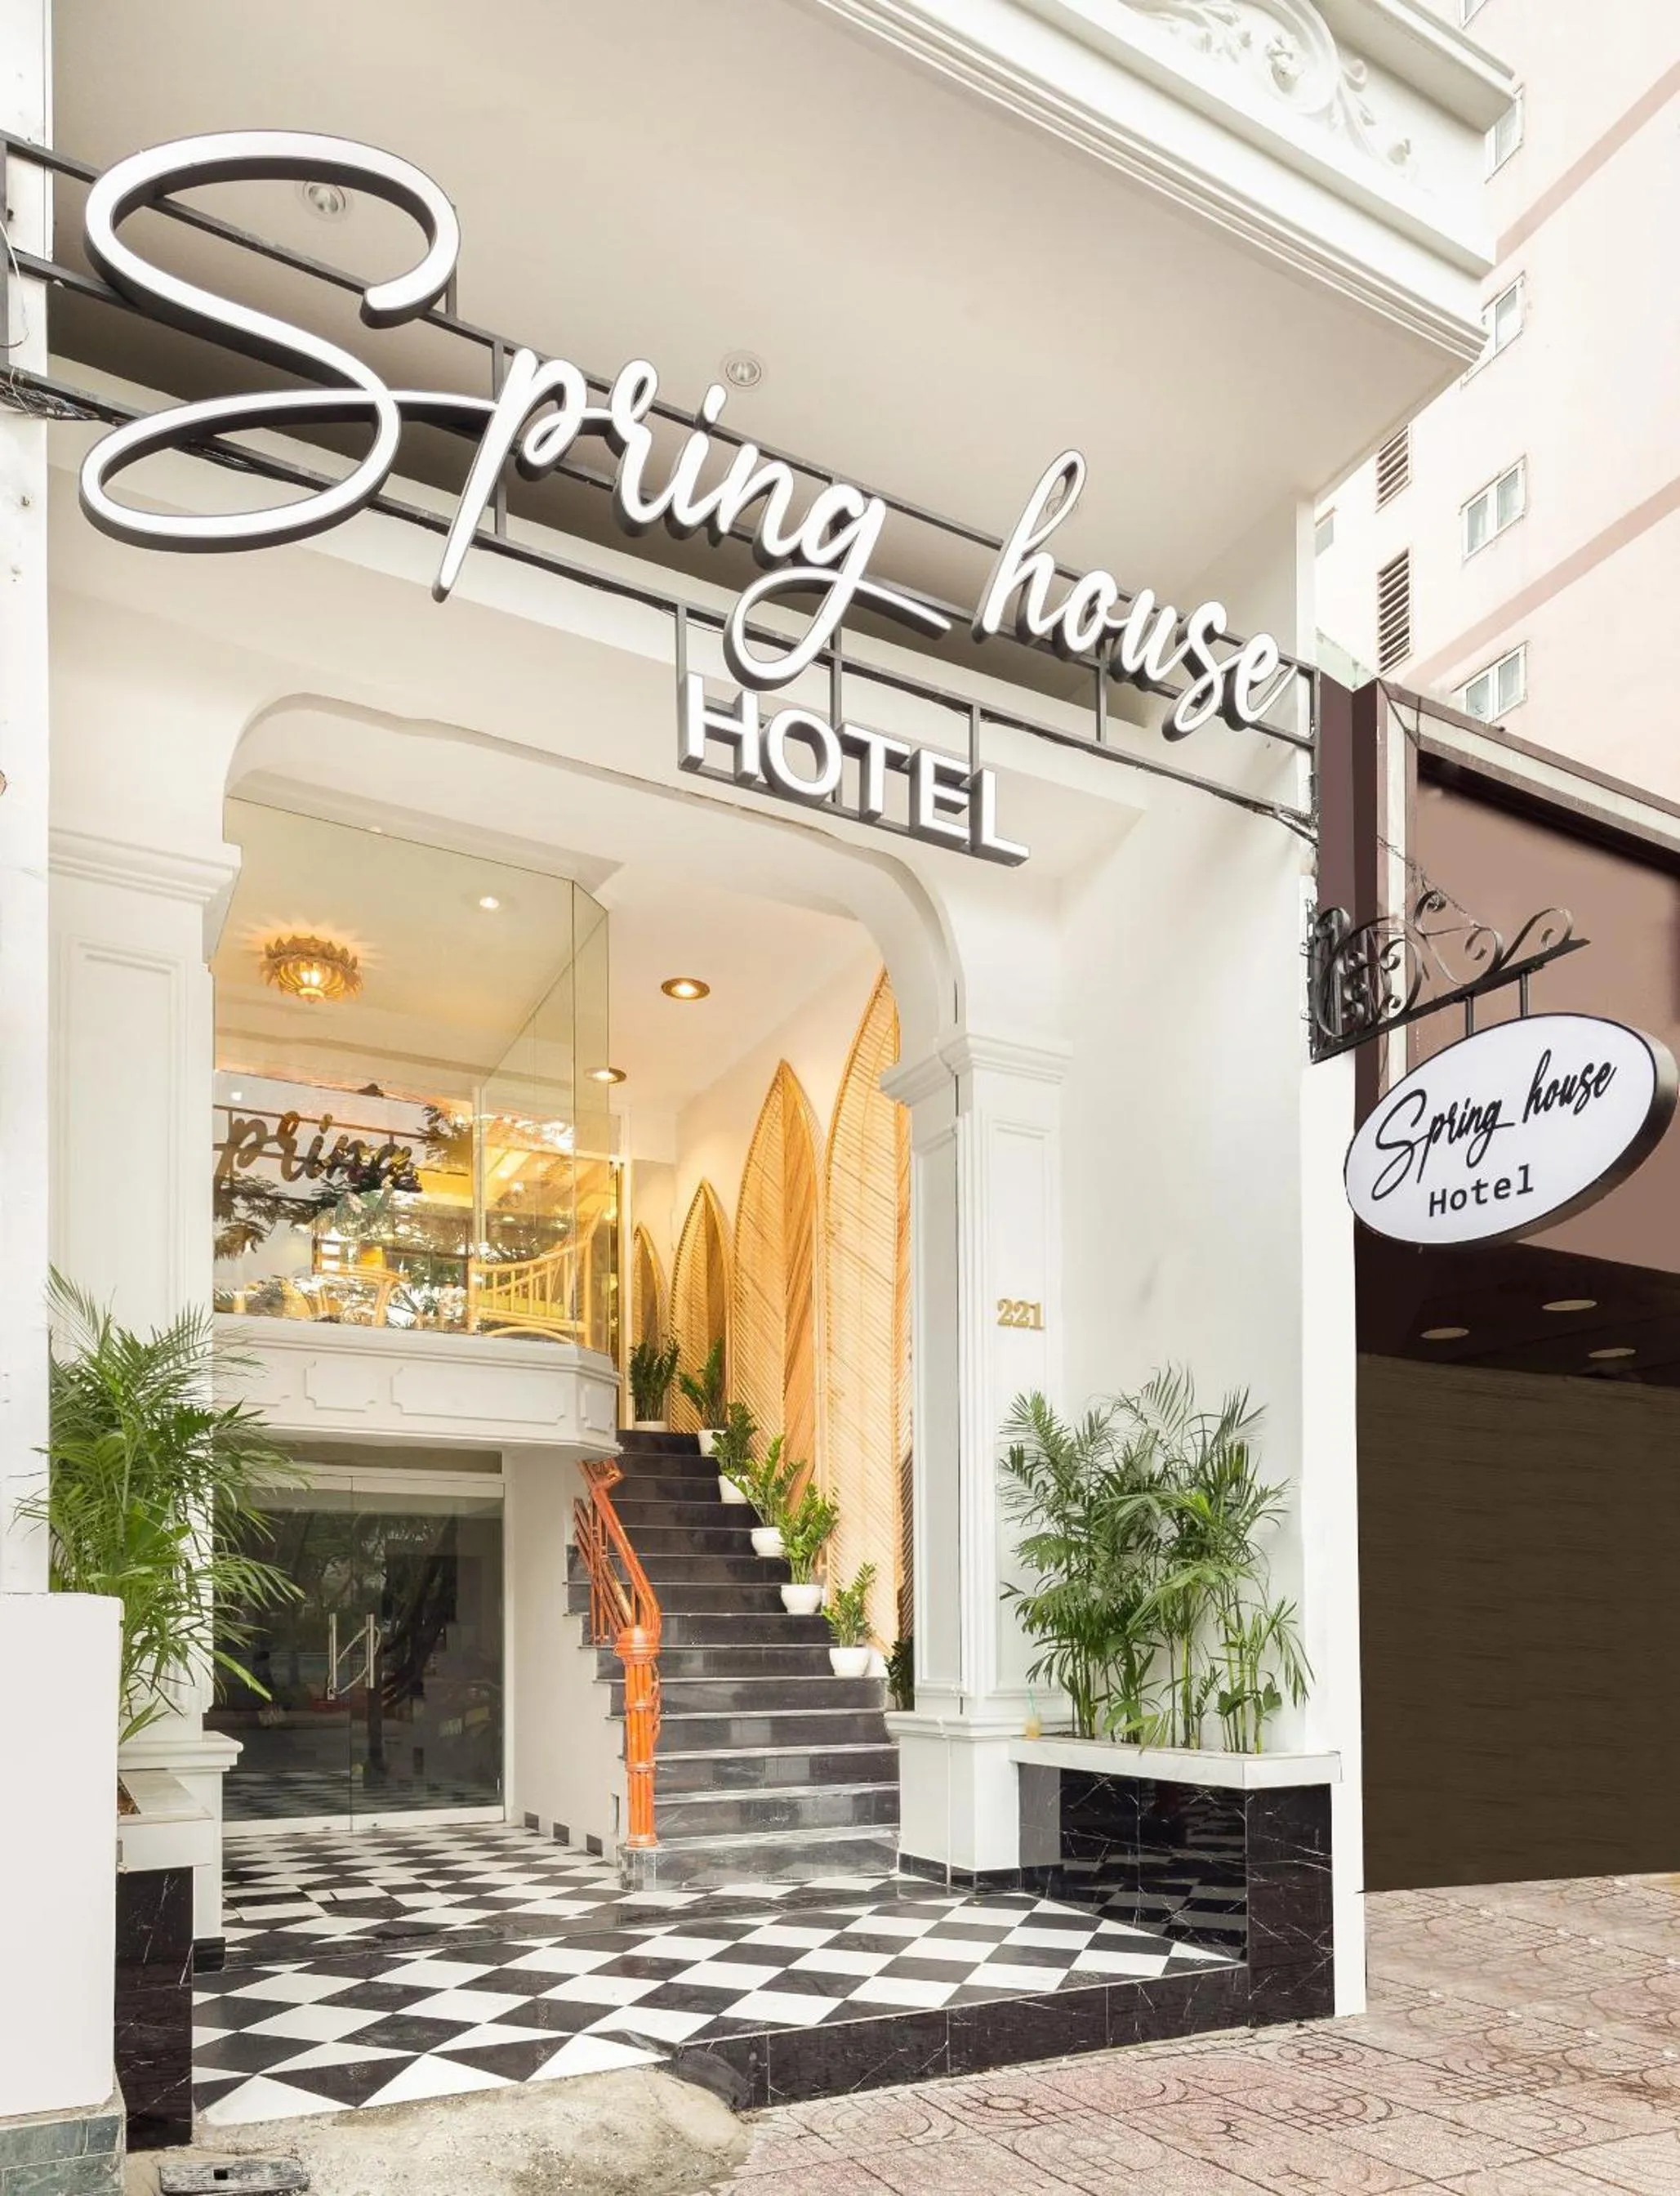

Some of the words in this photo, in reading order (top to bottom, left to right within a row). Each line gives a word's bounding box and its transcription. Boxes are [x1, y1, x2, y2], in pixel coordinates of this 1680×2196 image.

[79, 130, 953, 691] Spring
[971, 449, 1299, 742] house
[678, 672, 1030, 867] HOTEL
[1372, 1089, 1515, 1202] Spring
[1522, 1049, 1617, 1124] house
[1428, 1163, 1534, 1217] Hotel
[996, 1298, 1045, 1330] 221
